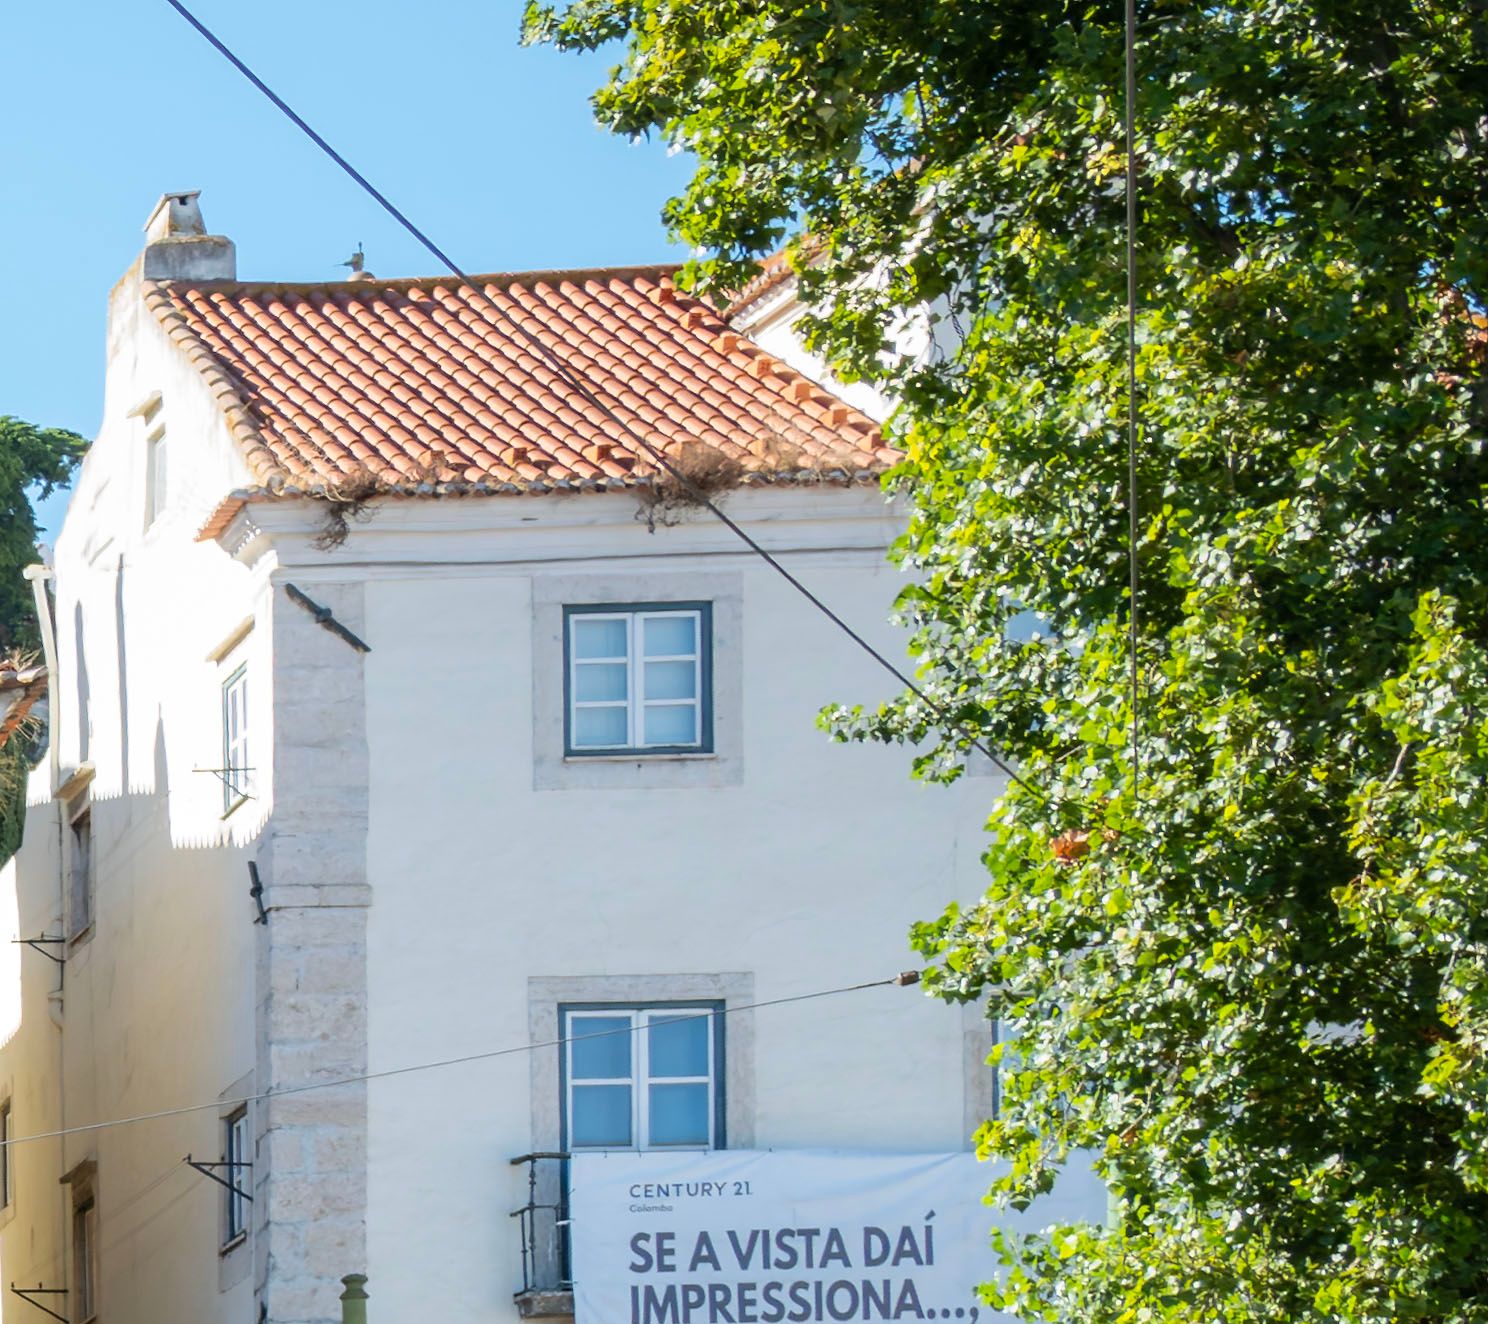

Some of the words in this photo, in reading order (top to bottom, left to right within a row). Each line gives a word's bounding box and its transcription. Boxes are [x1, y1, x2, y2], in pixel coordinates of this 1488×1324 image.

[629, 1182, 727, 1198] CENTURY
[629, 1231, 676, 1274] SE
[688, 1230, 722, 1272] A
[726, 1227, 853, 1271] VISTA
[863, 1209, 936, 1267] DAÍ
